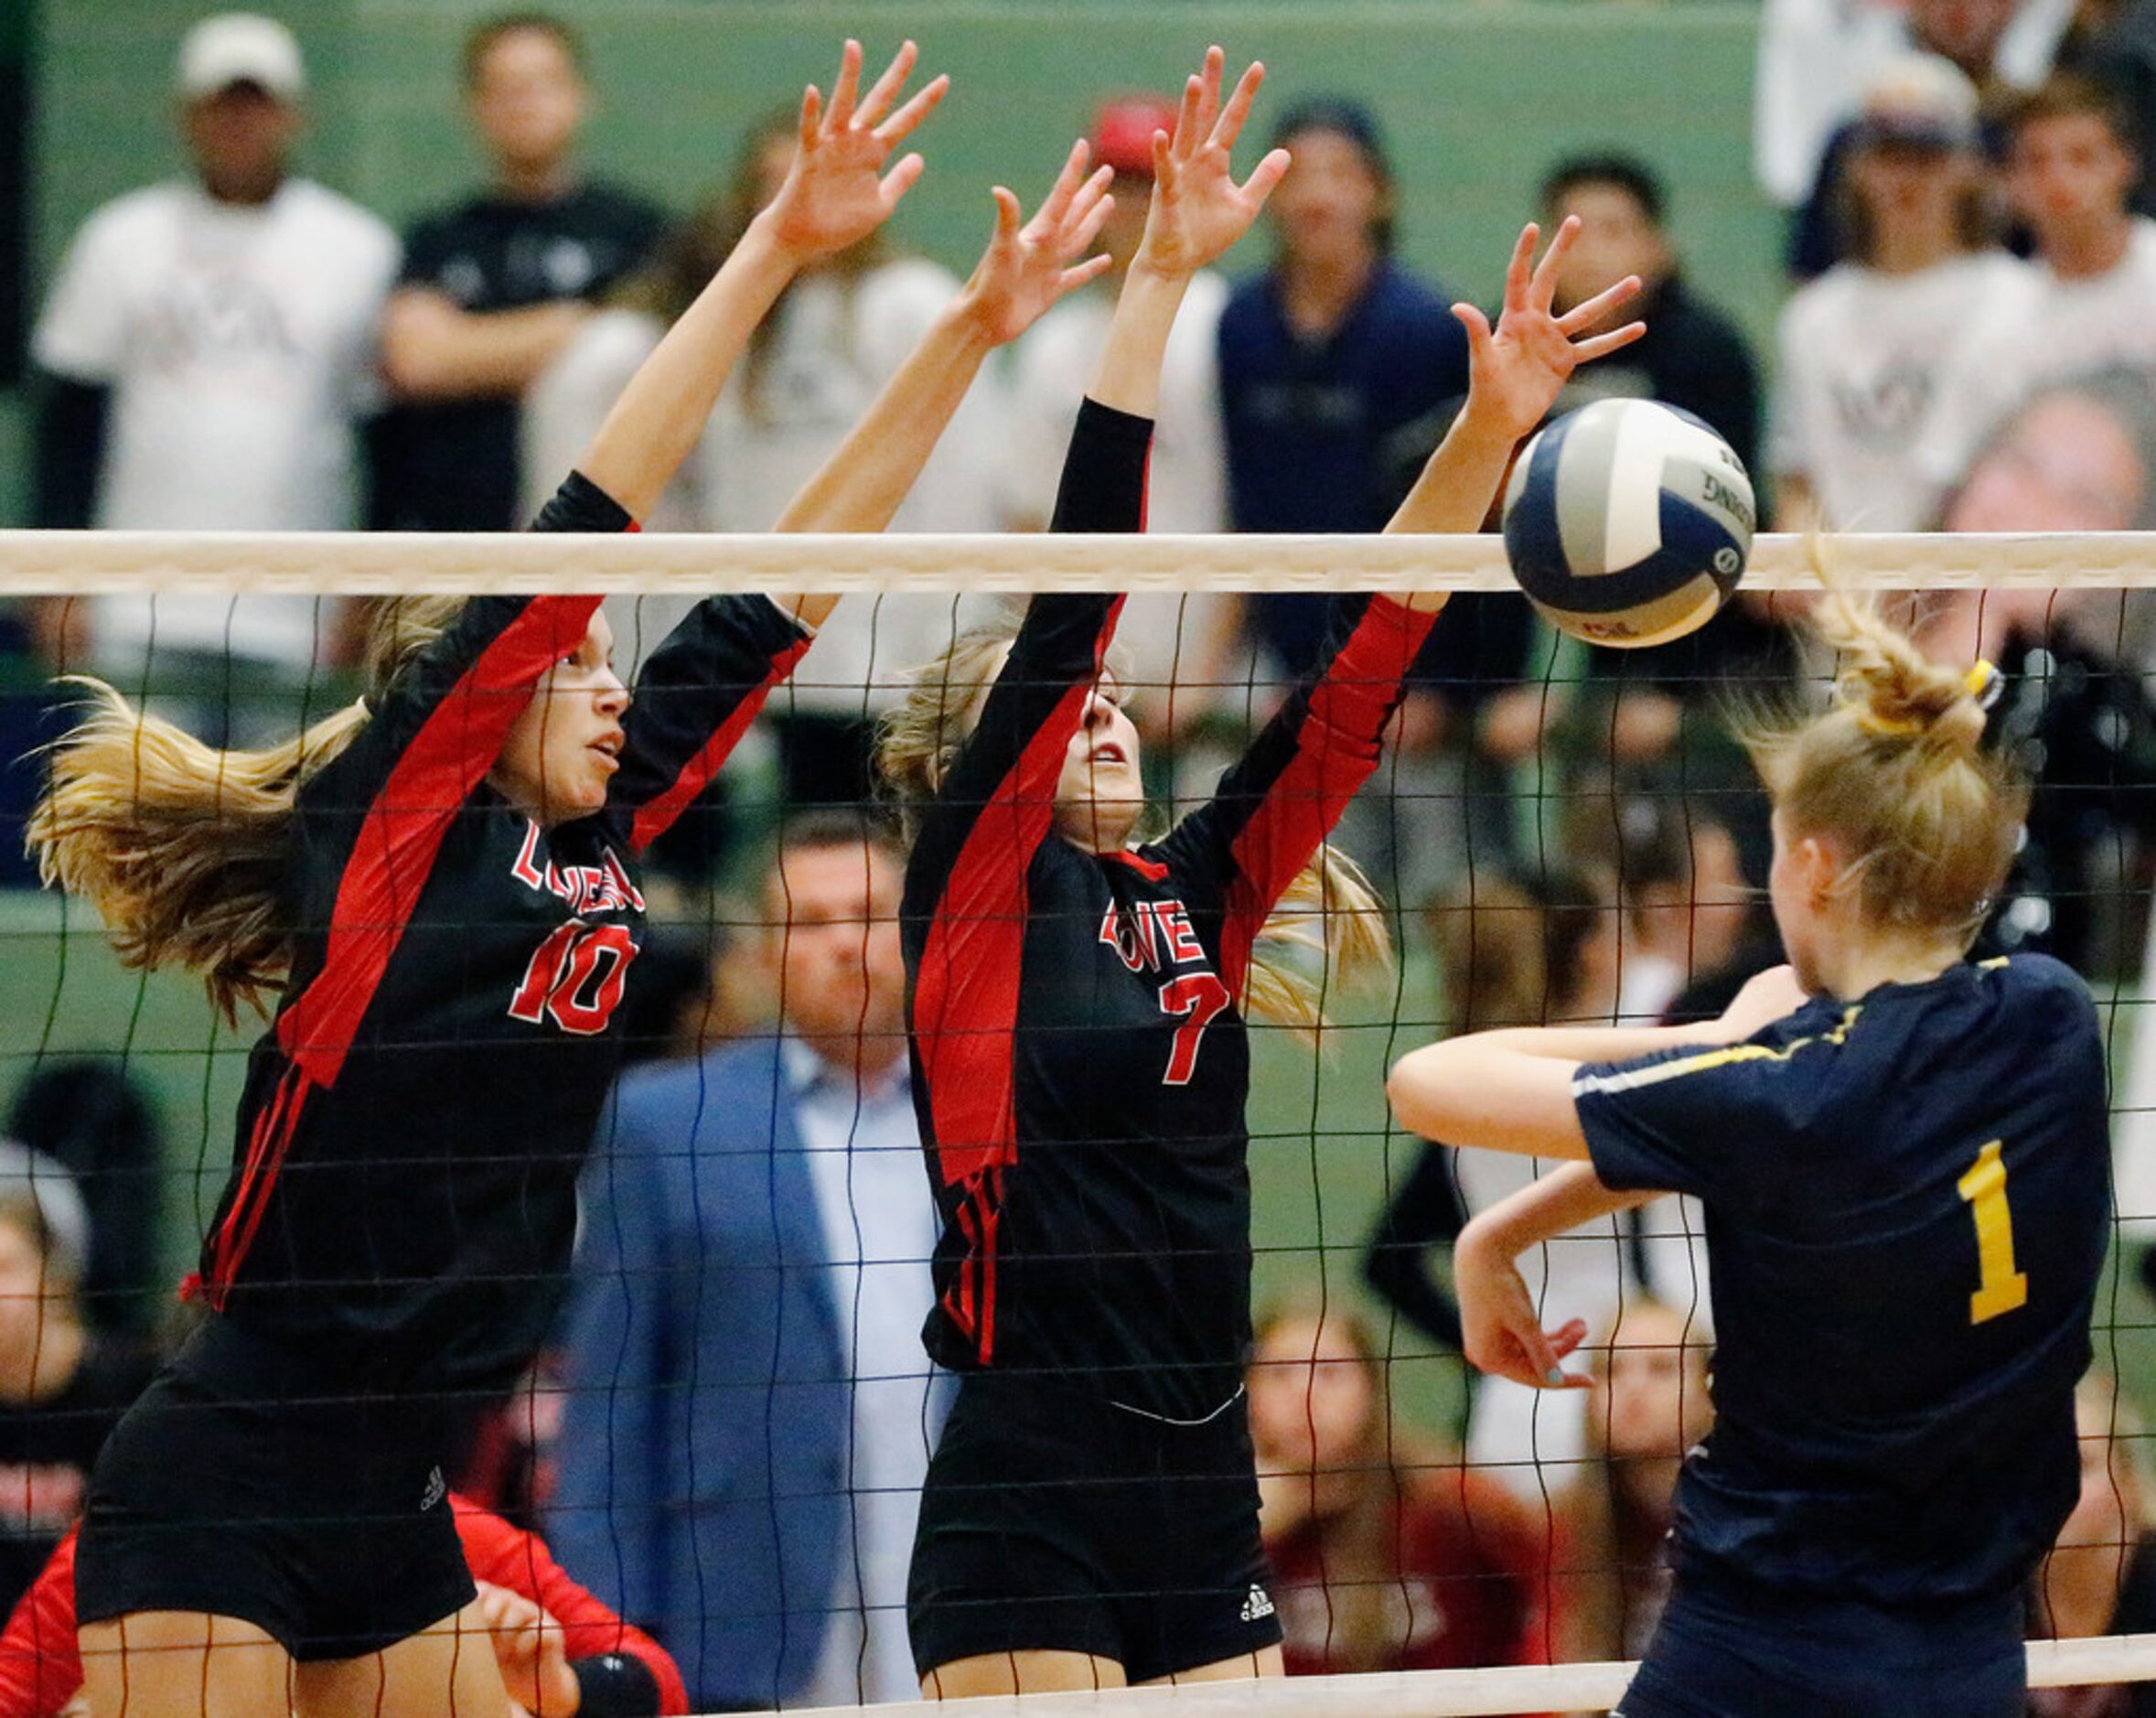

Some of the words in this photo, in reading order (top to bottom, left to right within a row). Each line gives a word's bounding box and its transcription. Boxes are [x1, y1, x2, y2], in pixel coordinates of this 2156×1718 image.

[508, 917, 640, 1036] 10
[1158, 972, 1230, 1086] 7
[1957, 1139, 2028, 1326] 1
